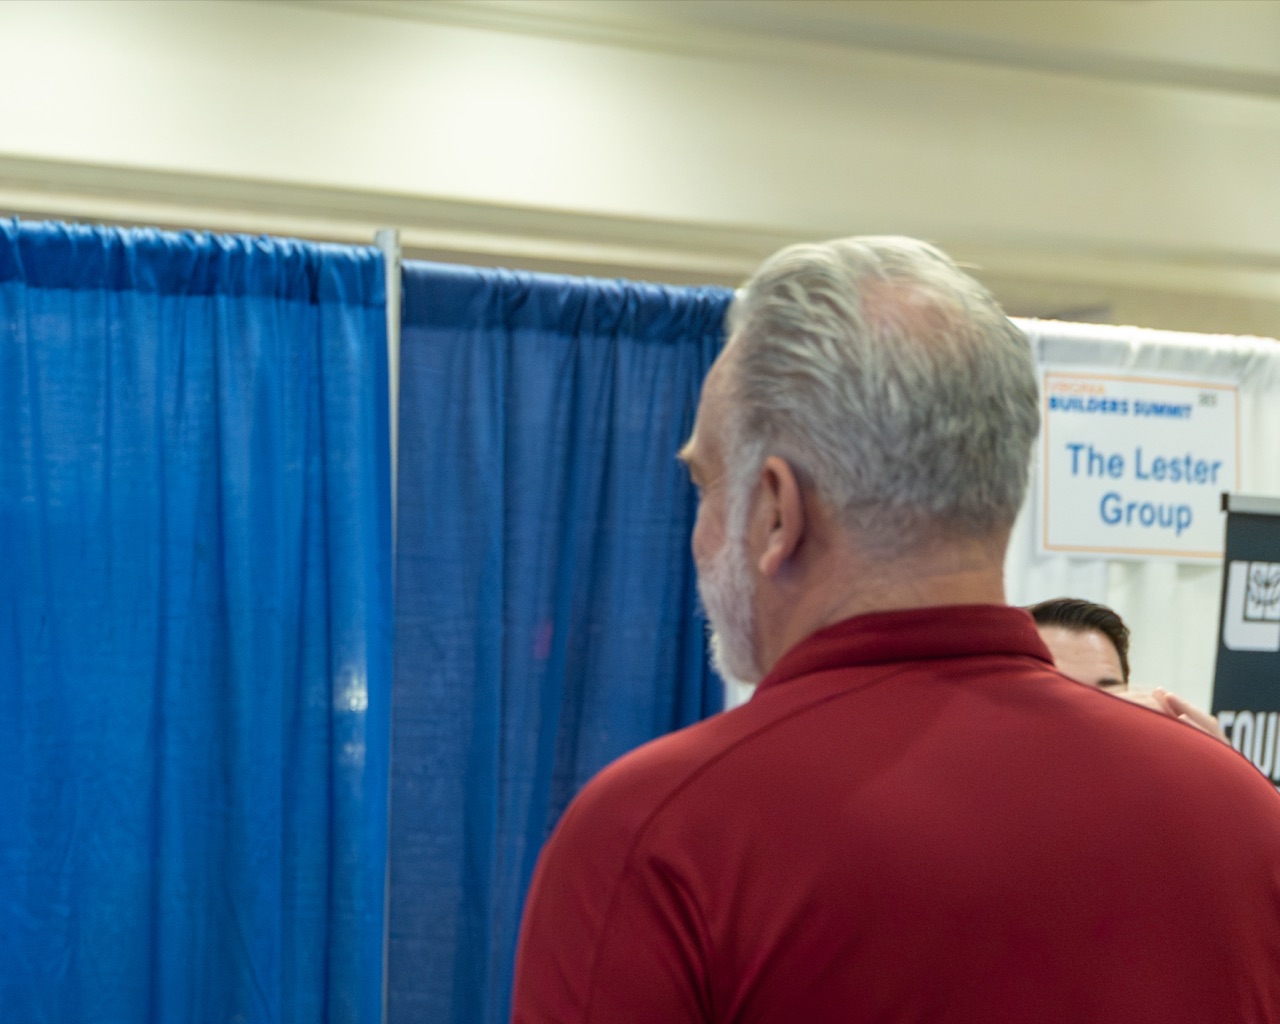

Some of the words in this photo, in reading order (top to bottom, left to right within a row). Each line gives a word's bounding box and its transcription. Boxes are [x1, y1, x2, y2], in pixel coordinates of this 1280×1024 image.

[1066, 442, 1125, 479] The
[1135, 448, 1223, 485] Lester
[1099, 492, 1193, 538] Group
